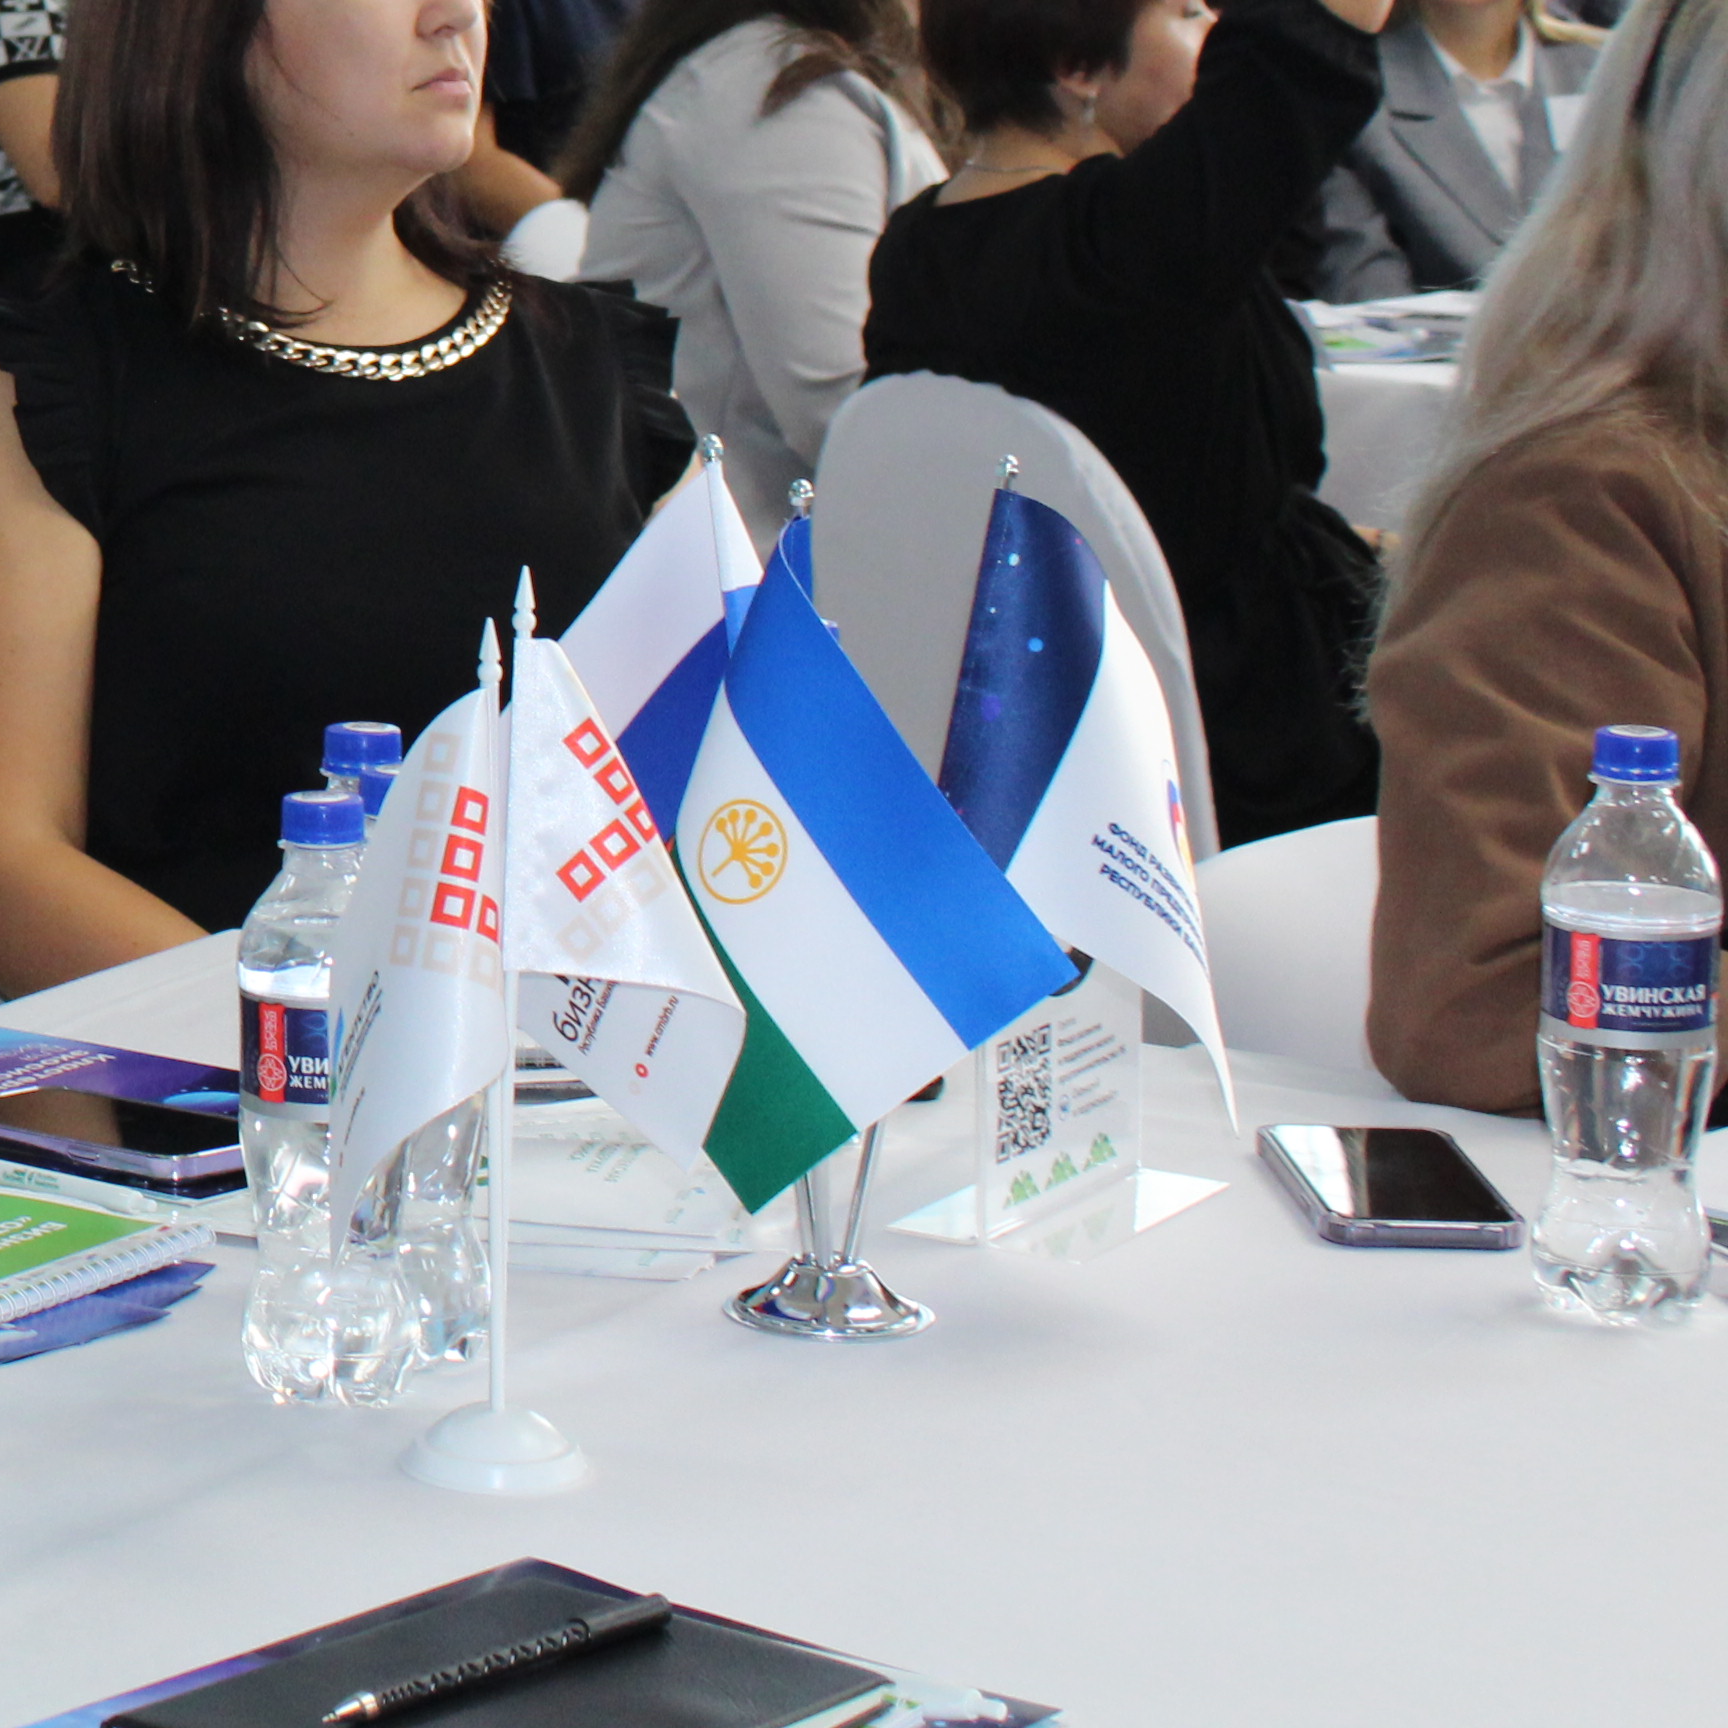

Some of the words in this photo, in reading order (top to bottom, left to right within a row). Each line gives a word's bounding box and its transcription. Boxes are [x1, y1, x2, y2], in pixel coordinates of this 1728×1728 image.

[1090, 833, 1151, 882] МАЛОГО
[1107, 822, 1149, 860] ФОНД
[1600, 983, 1707, 1004] УВИНСКАЯ
